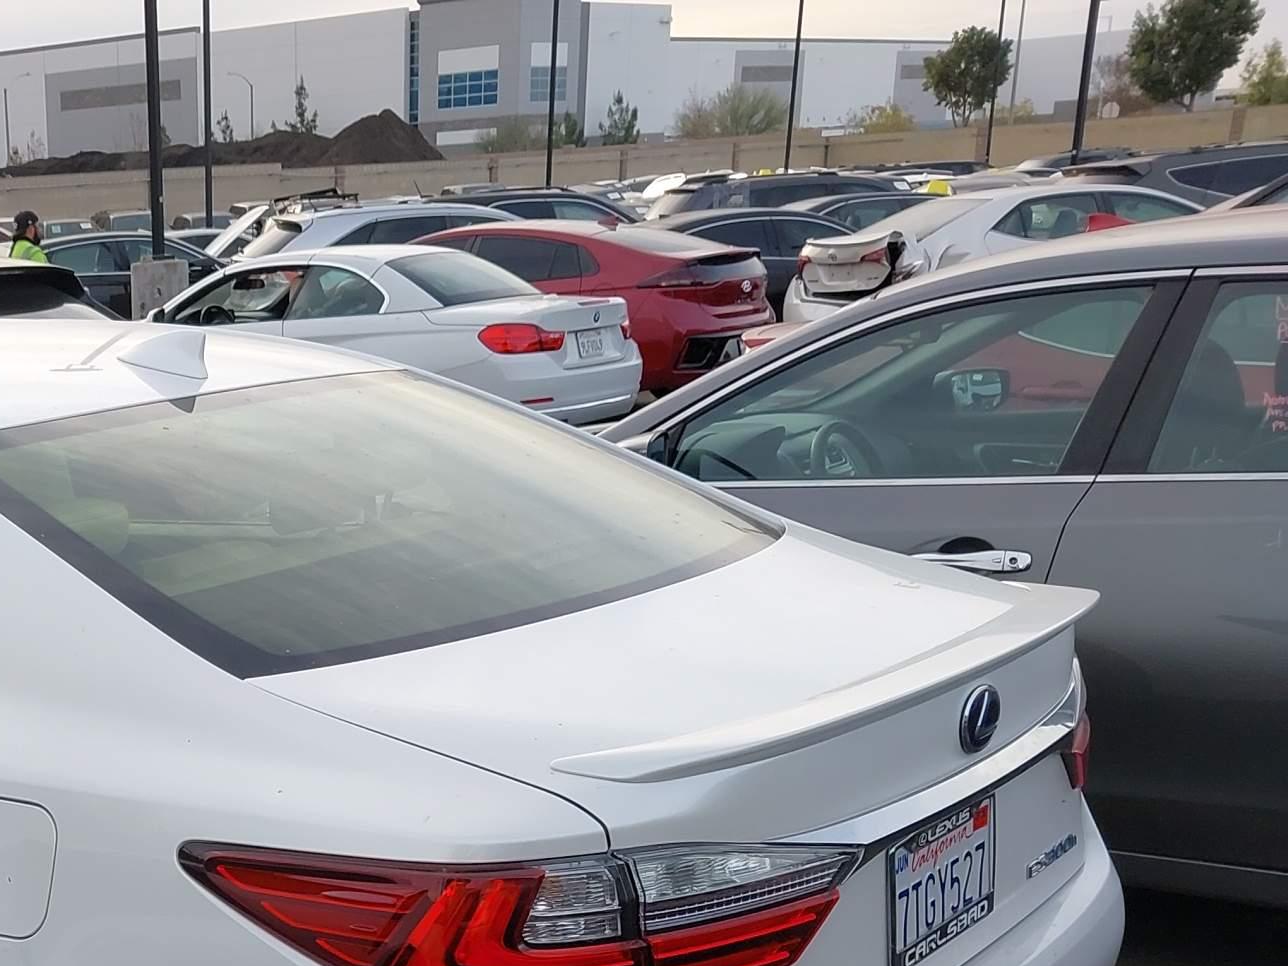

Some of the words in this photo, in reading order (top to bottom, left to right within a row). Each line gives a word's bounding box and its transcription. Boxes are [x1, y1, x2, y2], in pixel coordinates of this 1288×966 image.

[927, 807, 971, 841] LEXUS
[896, 852, 909, 875] JUN
[912, 826, 974, 873] California
[898, 840, 986, 949] 7TGY527
